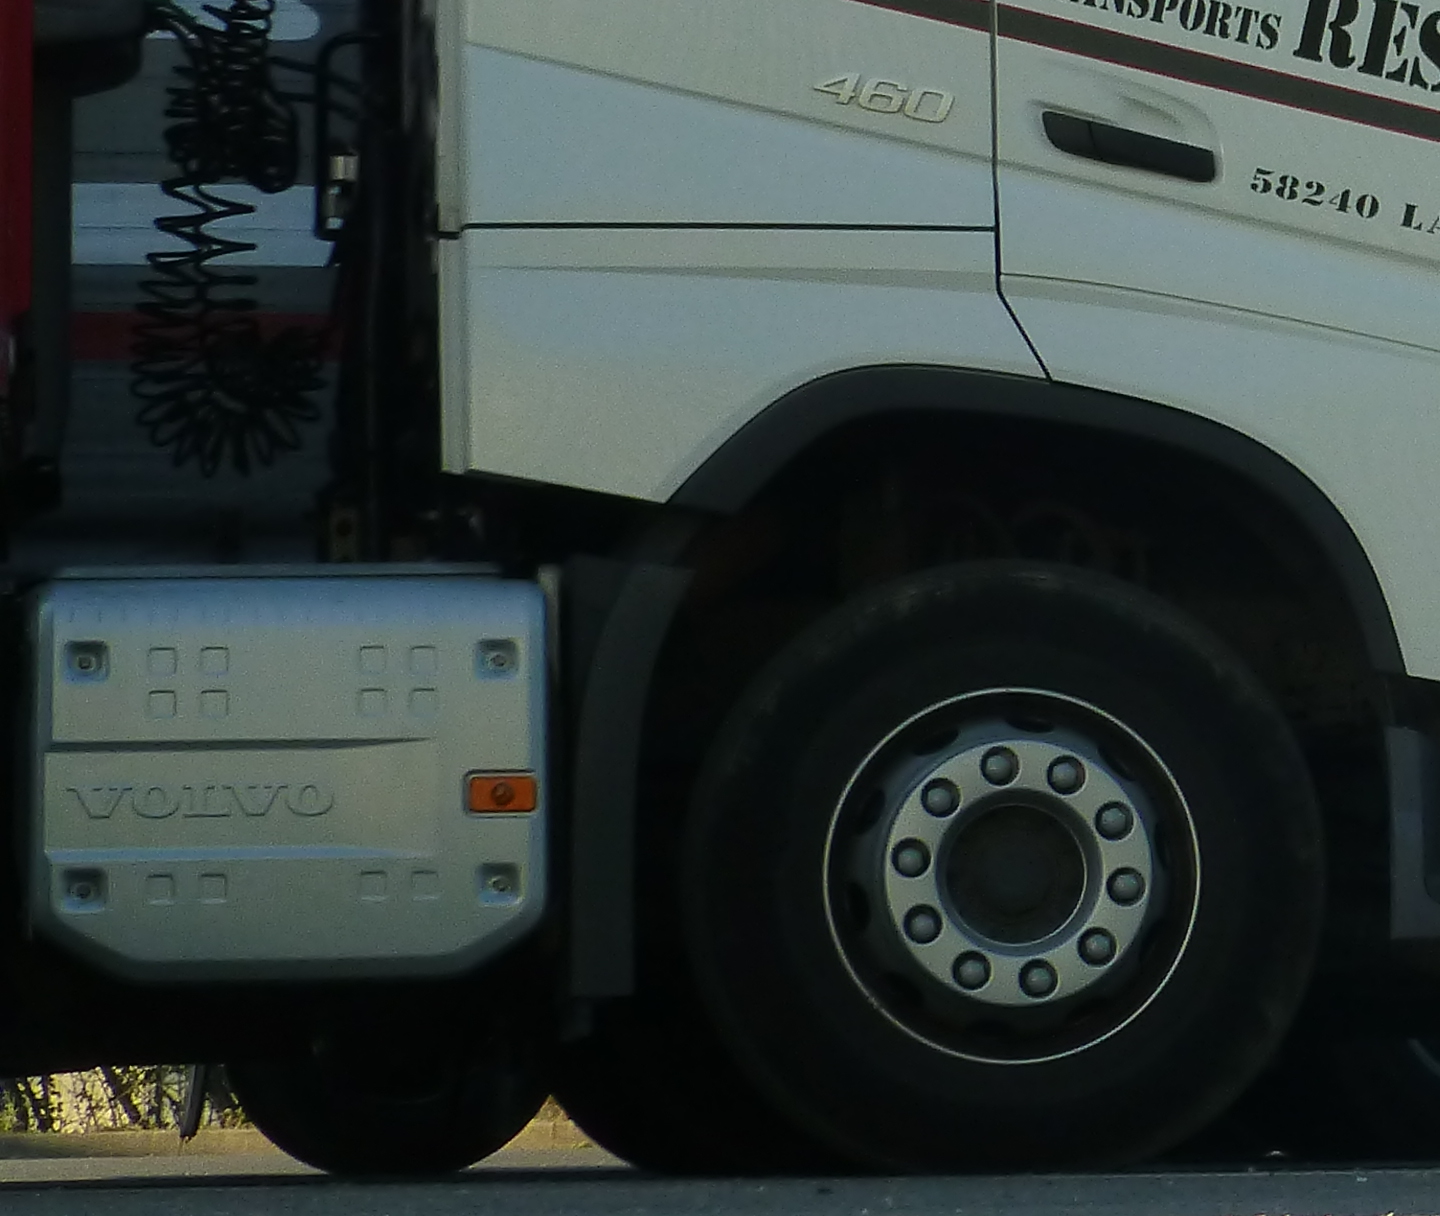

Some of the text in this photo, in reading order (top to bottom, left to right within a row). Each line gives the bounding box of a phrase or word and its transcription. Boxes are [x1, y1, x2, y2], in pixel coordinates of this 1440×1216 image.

[811, 72, 955, 124] 460
[1248, 166, 1380, 220] 58240
[66, 784, 337, 821] VOLVO
